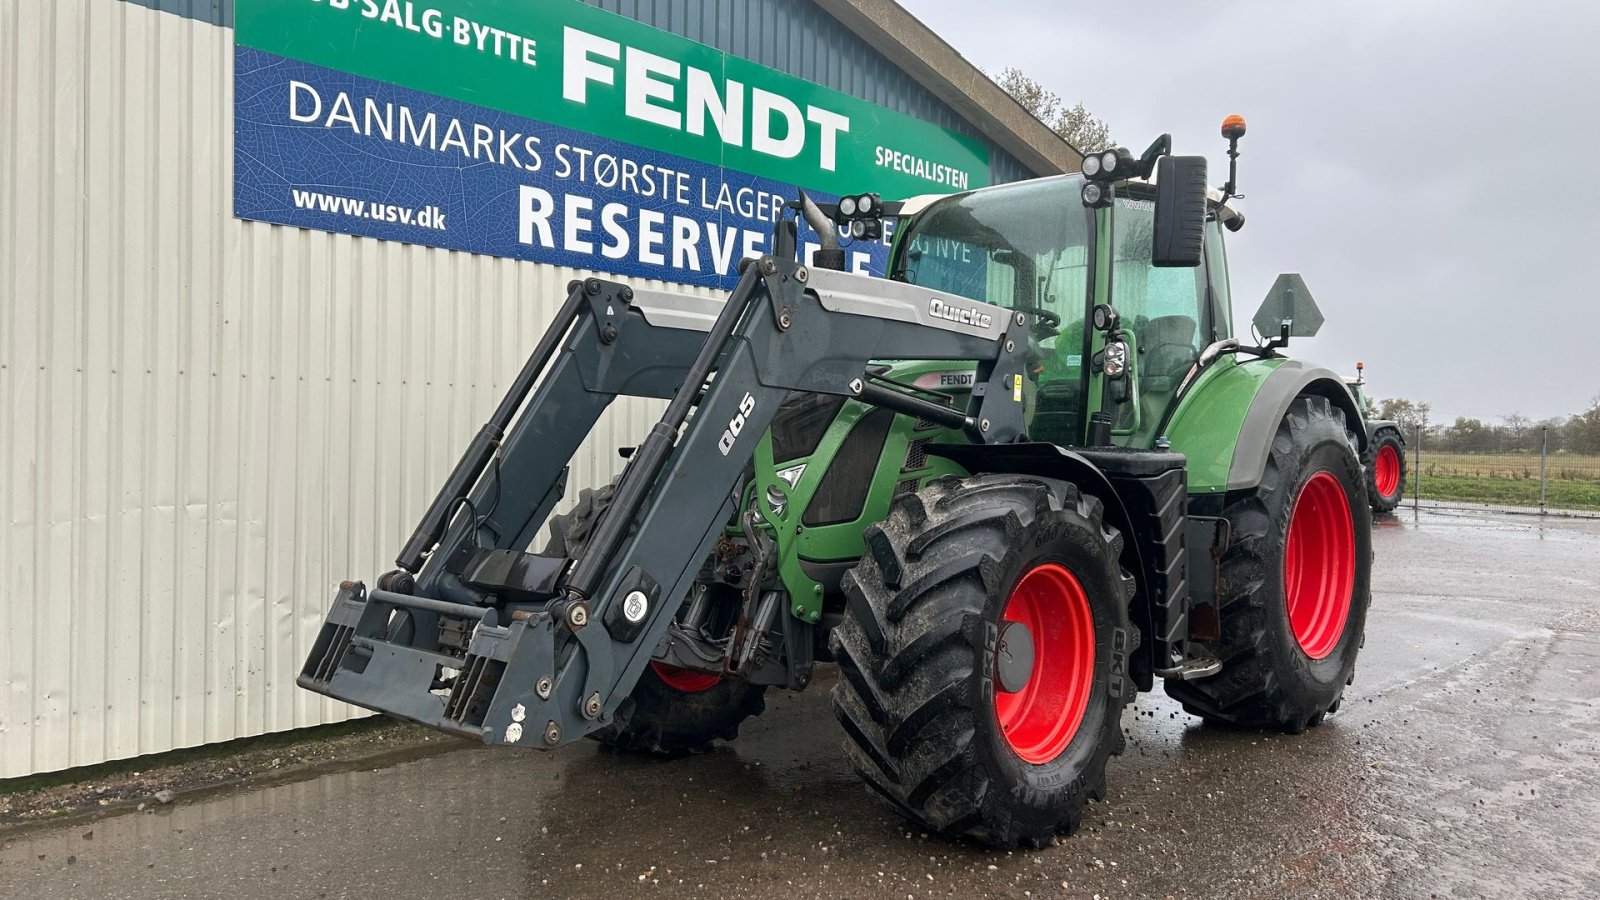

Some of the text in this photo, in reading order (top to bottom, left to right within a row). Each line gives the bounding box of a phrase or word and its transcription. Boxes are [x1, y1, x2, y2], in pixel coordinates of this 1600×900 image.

[562, 25, 850, 172] FENDT
[289, 79, 542, 171] DANMARKS
[554, 143, 691, 204] STØRSTE
[701, 177, 784, 223] LAGER
[875, 145, 968, 190] SPECIALISTEN
[292, 188, 446, 231] www.usv.dk
[929, 298, 992, 329] Quicke
[940, 374, 973, 386] FENDT
[718, 392, 756, 457] Q65
[1109, 627, 1127, 698] BKT
